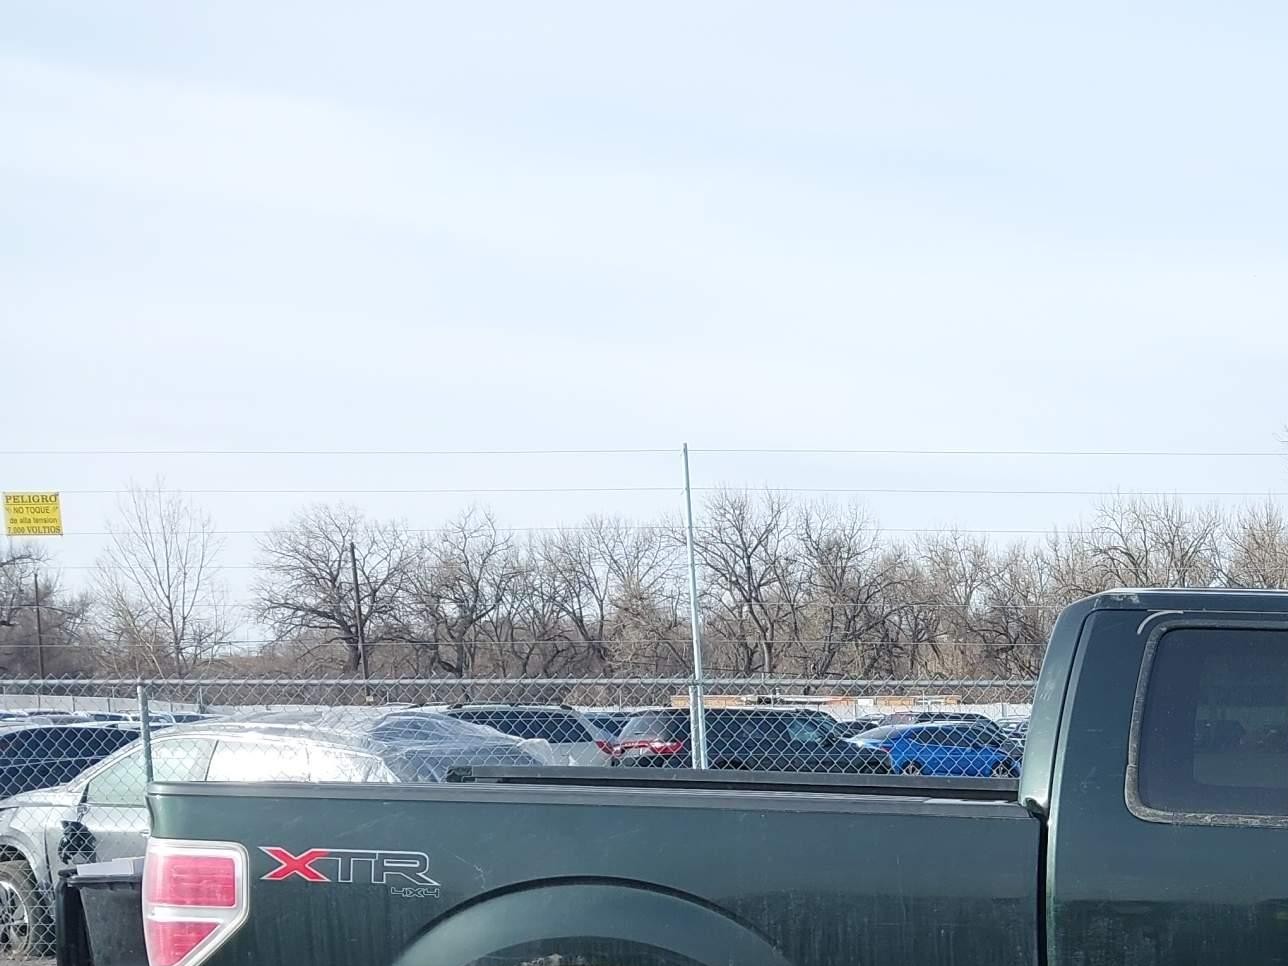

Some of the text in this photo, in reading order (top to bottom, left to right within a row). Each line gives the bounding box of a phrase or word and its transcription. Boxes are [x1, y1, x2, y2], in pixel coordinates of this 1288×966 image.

[5, 495, 57, 503] PELIGRO
[25, 506, 51, 514] TOQUE
[258, 846, 441, 886] XTR
